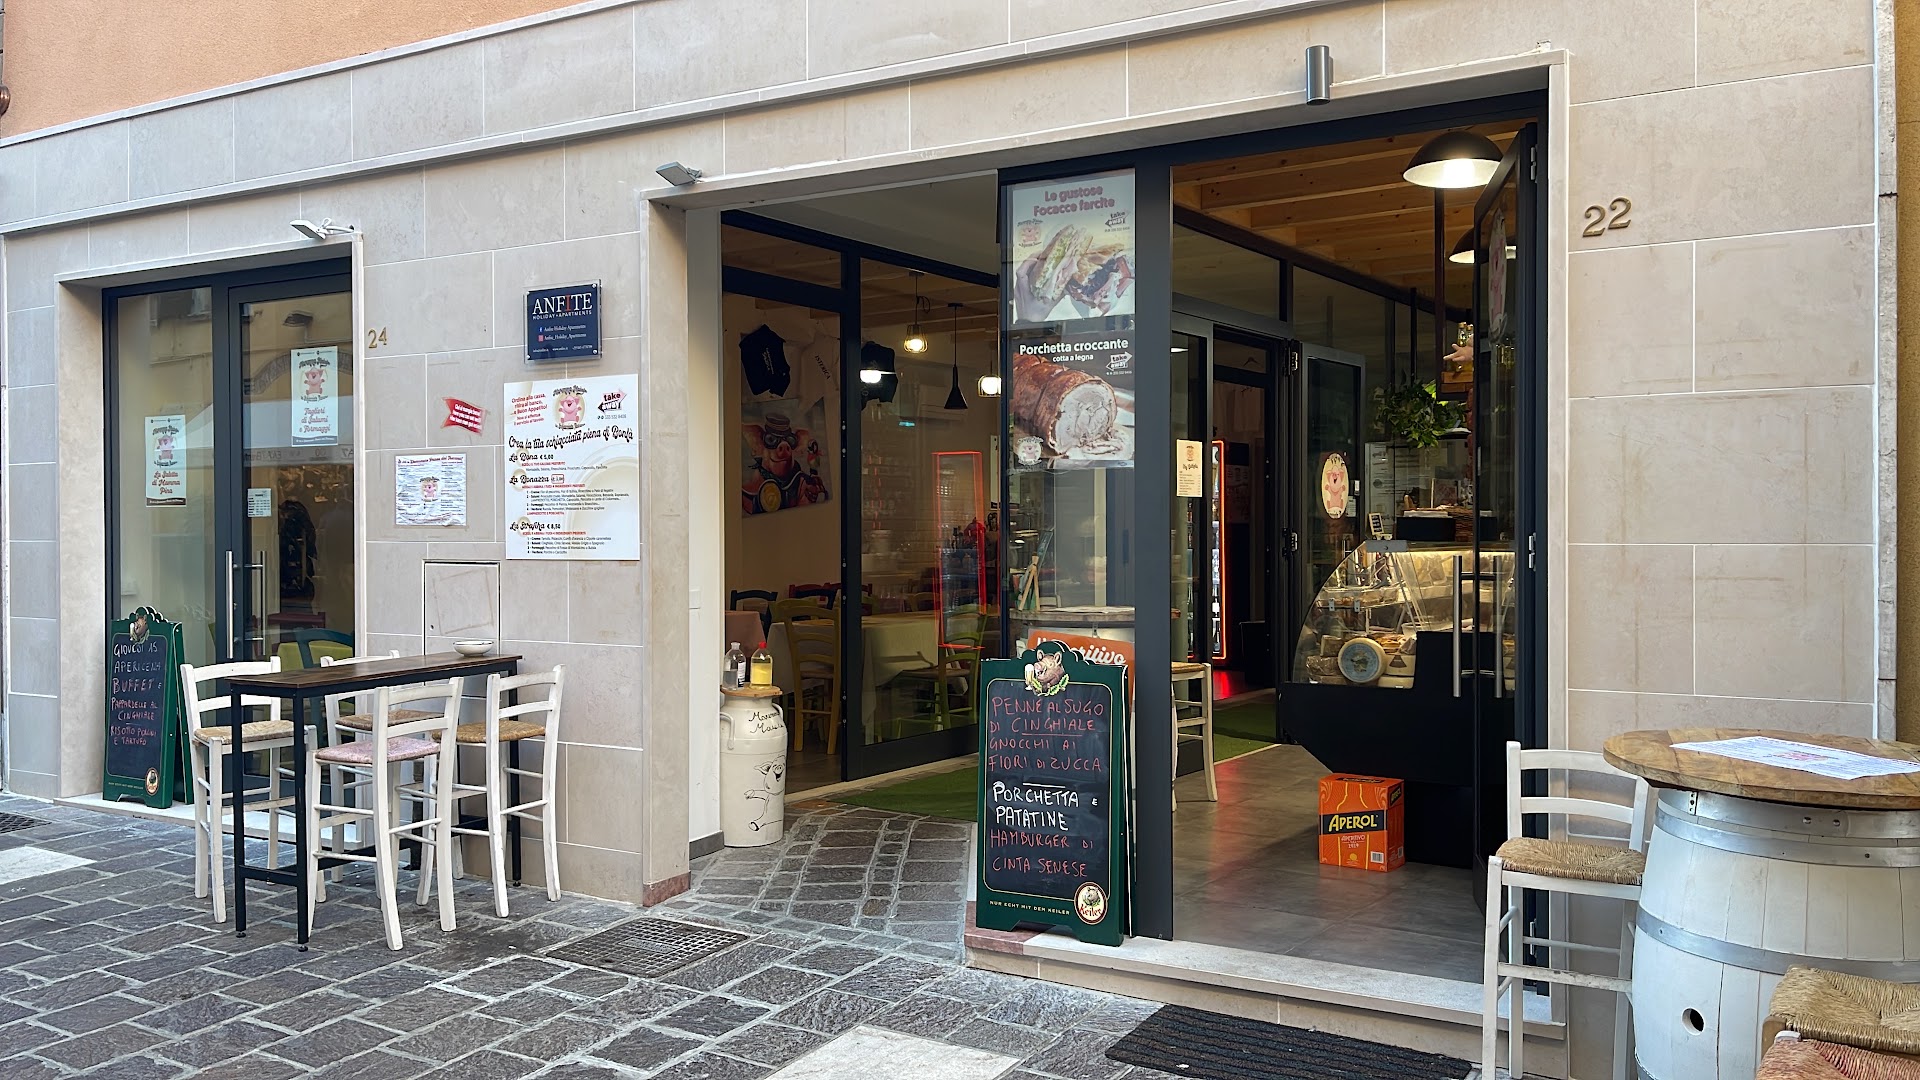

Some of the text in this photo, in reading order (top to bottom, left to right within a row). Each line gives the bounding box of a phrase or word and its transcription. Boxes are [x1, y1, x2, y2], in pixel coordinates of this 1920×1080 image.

[1044, 185, 1103, 202] Le gustose
[1033, 197, 1115, 217] Focacce farcite
[1583, 196, 1632, 237] 22
[532, 293, 592, 315] ANFITE
[559, 310, 592, 318] APARTMENTS
[368, 326, 388, 349] 24
[1020, 339, 1129, 355] Porchetta croccante
[1075, 354, 1094, 362] legna
[604, 393, 621, 402] take
[508, 435, 524, 449] Crea
[525, 439, 532, 449] la
[533, 438, 544, 449] tua
[582, 428, 601, 443] piena
[603, 425, 610, 441] di
[509, 453, 518, 462] La
[519, 452, 538, 461] Bona
[509, 475, 518, 485] La
[509, 522, 519, 531] La
[112, 678, 155, 694] BUFFET
[991, 696, 1104, 717] PENNE AL SUGO
[110, 725, 136, 737] RISOTTO
[990, 717, 1096, 733] DI CINGHIALE
[121, 737, 147, 745] TARTUFO
[989, 738, 1076, 750] GNOCCHI AI
[988, 754, 1102, 772] FIORI DI ZUCCA
[993, 781, 1098, 808] PORCHETTA E
[996, 805, 1069, 831] PATATINE
[1328, 814, 1377, 832] APEROL
[990, 828, 1093, 849] HAMBURGER DI
[992, 856, 1088, 877] CINTA SENESE
[1047, 907, 1070, 915] KEILER
[1078, 904, 1102, 917] Keiler
